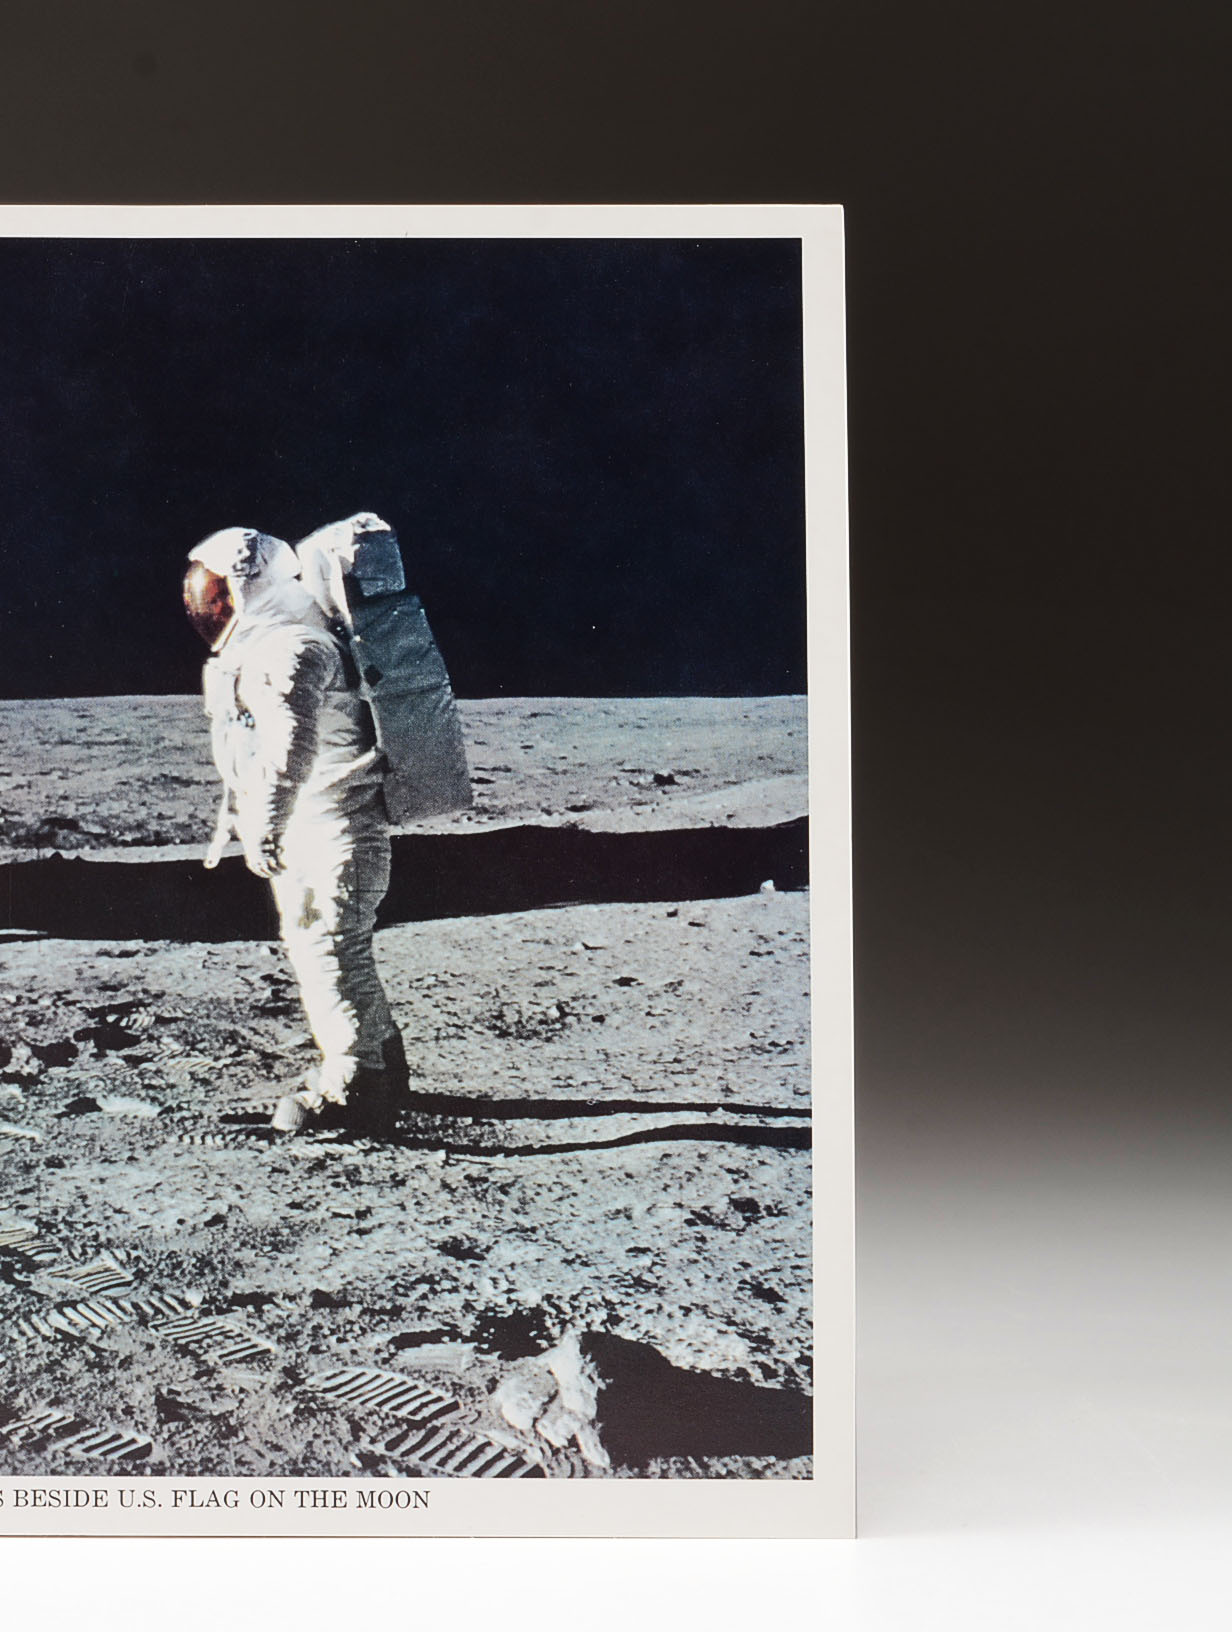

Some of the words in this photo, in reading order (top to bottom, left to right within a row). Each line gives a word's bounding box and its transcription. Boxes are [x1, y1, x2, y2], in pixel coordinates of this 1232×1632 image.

[12, 1489, 109, 1508] BESIDE
[117, 1489, 163, 1509] U.S.
[170, 1489, 240, 1509] FLAG
[248, 1489, 286, 1509] ON
[293, 1489, 348, 1509] THE
[355, 1489, 431, 1510] MOON
